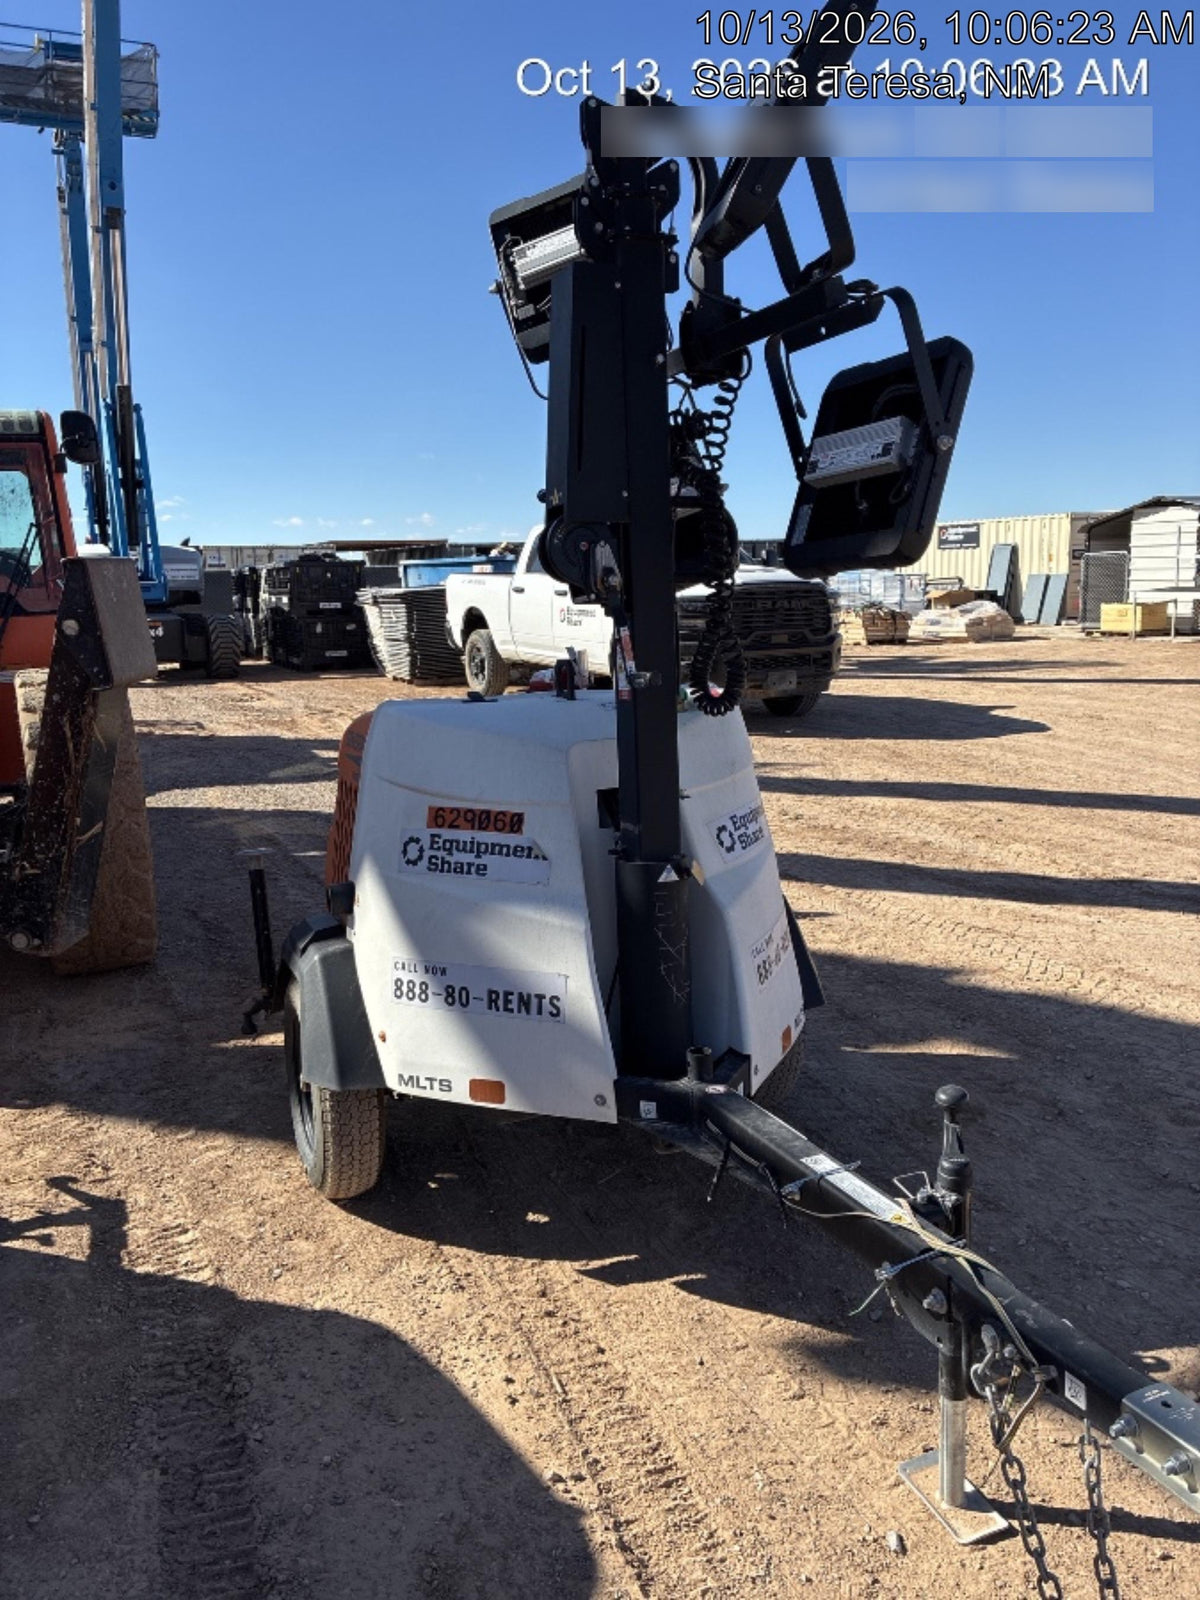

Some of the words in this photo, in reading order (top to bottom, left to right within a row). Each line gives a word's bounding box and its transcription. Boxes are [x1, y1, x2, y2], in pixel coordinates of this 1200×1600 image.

[434, 806, 525, 834] 629060
[426, 854, 488, 877] Share
[394, 961, 418, 974] CALL
[424, 964, 448, 977] NOW
[393, 977, 562, 1018] 888-80-RENTS
[397, 1073, 453, 1092] MLTS
